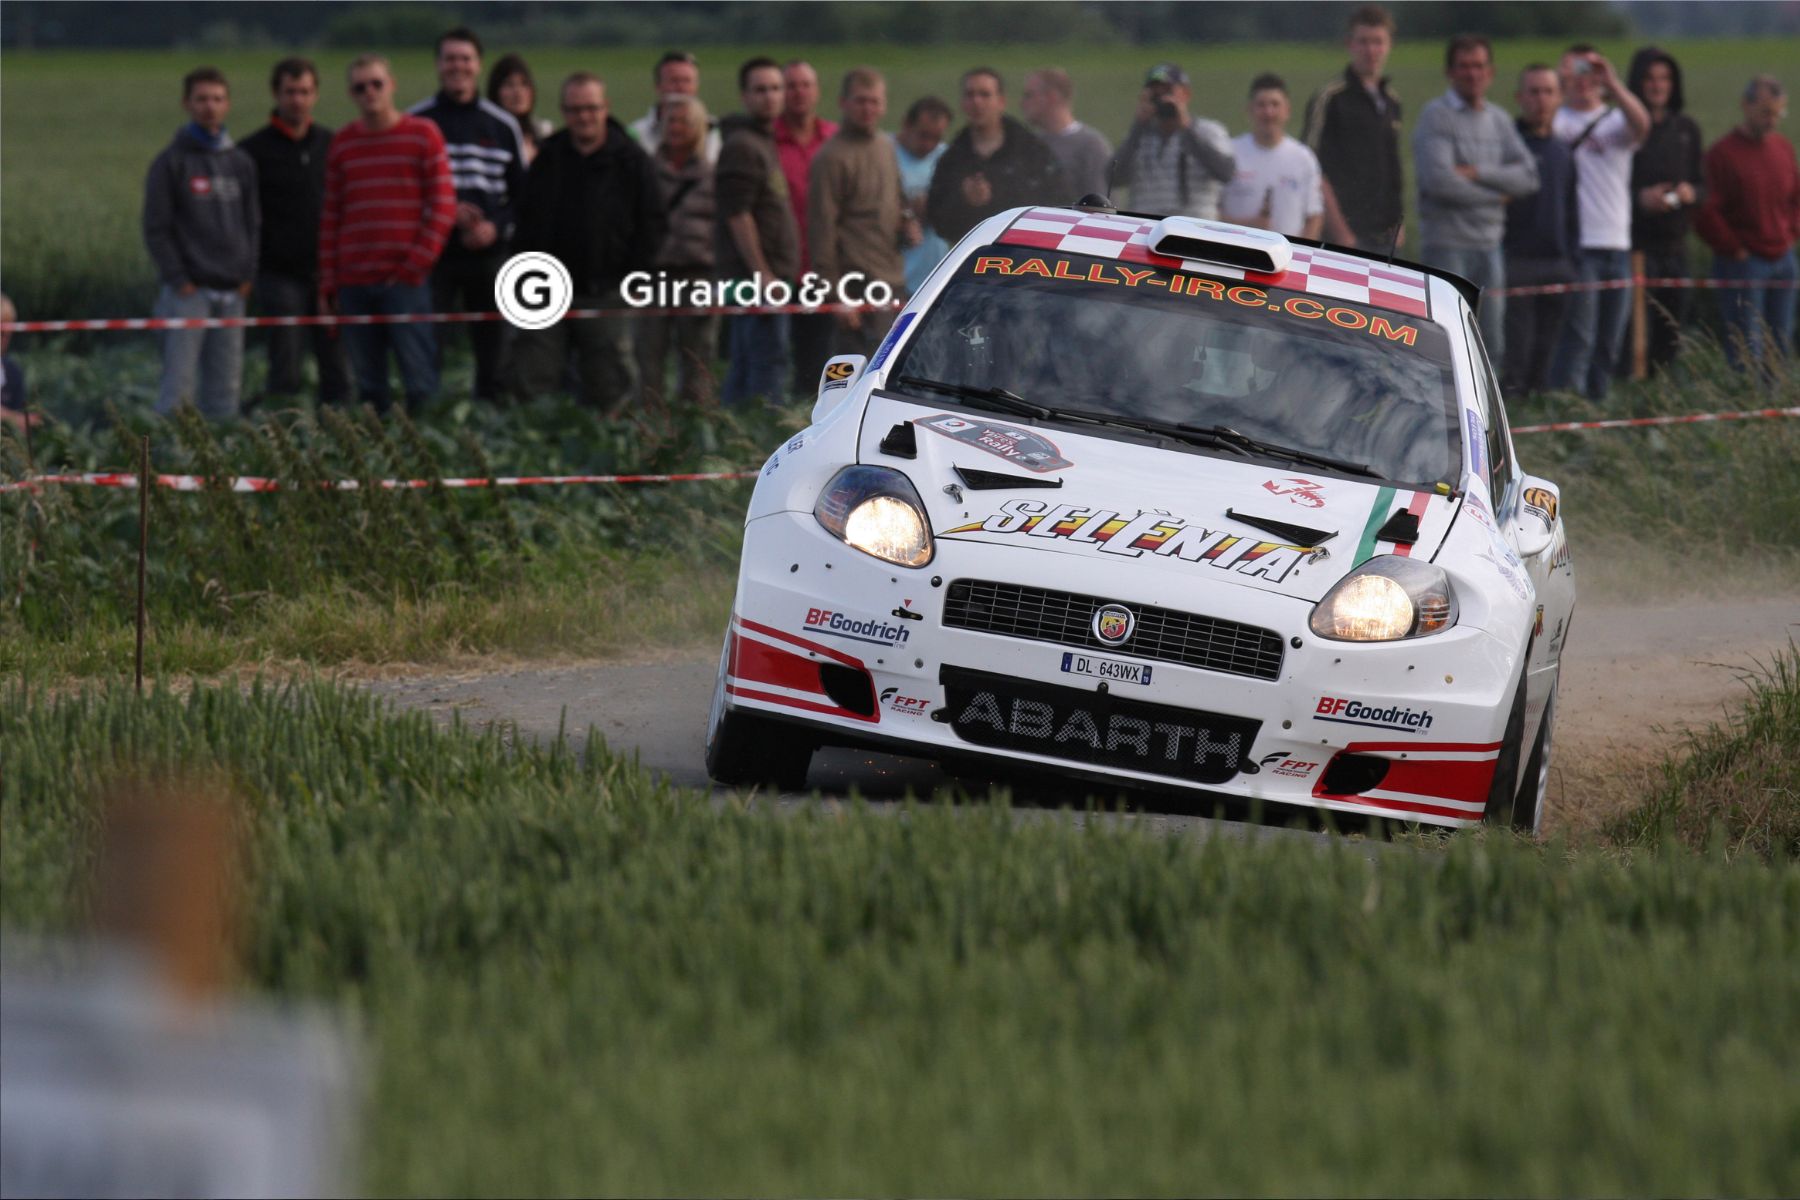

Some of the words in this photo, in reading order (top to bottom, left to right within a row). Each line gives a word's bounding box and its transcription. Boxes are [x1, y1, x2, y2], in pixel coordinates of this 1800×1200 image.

[973, 256, 1418, 346] RALLY-IRC.COM
[805, 607, 910, 642] BFGoodrich
[1077, 658, 1093, 673] DL
[1099, 662, 1140, 681] 643WX
[894, 695, 930, 708] FPT
[1315, 697, 1433, 728] BFGoodrich
[958, 691, 1241, 768] ABARTH
[1280, 759, 1319, 771] FPT
